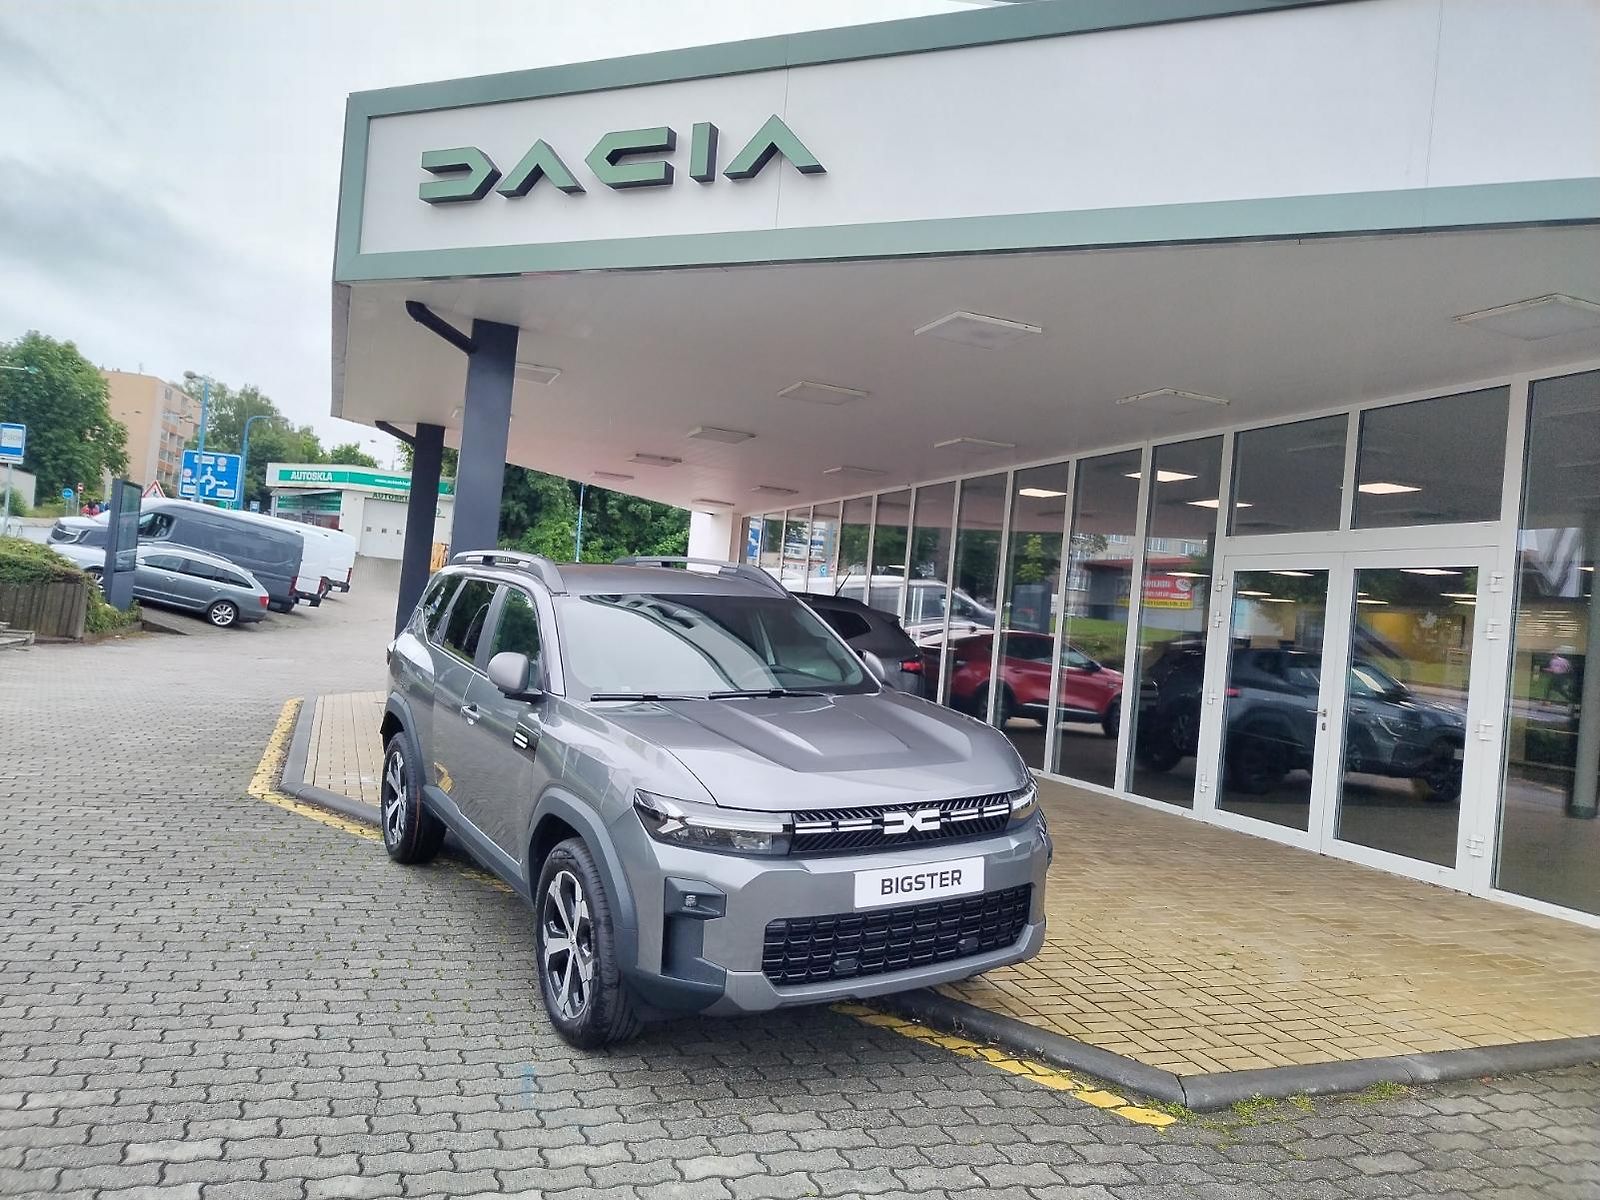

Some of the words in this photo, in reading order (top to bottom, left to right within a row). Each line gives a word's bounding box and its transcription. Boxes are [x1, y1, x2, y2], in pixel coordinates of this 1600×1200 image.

[419, 114, 827, 206] DACIA
[290, 471, 333, 481] AUTOSKLA
[880, 869, 962, 896] BIGSTER
